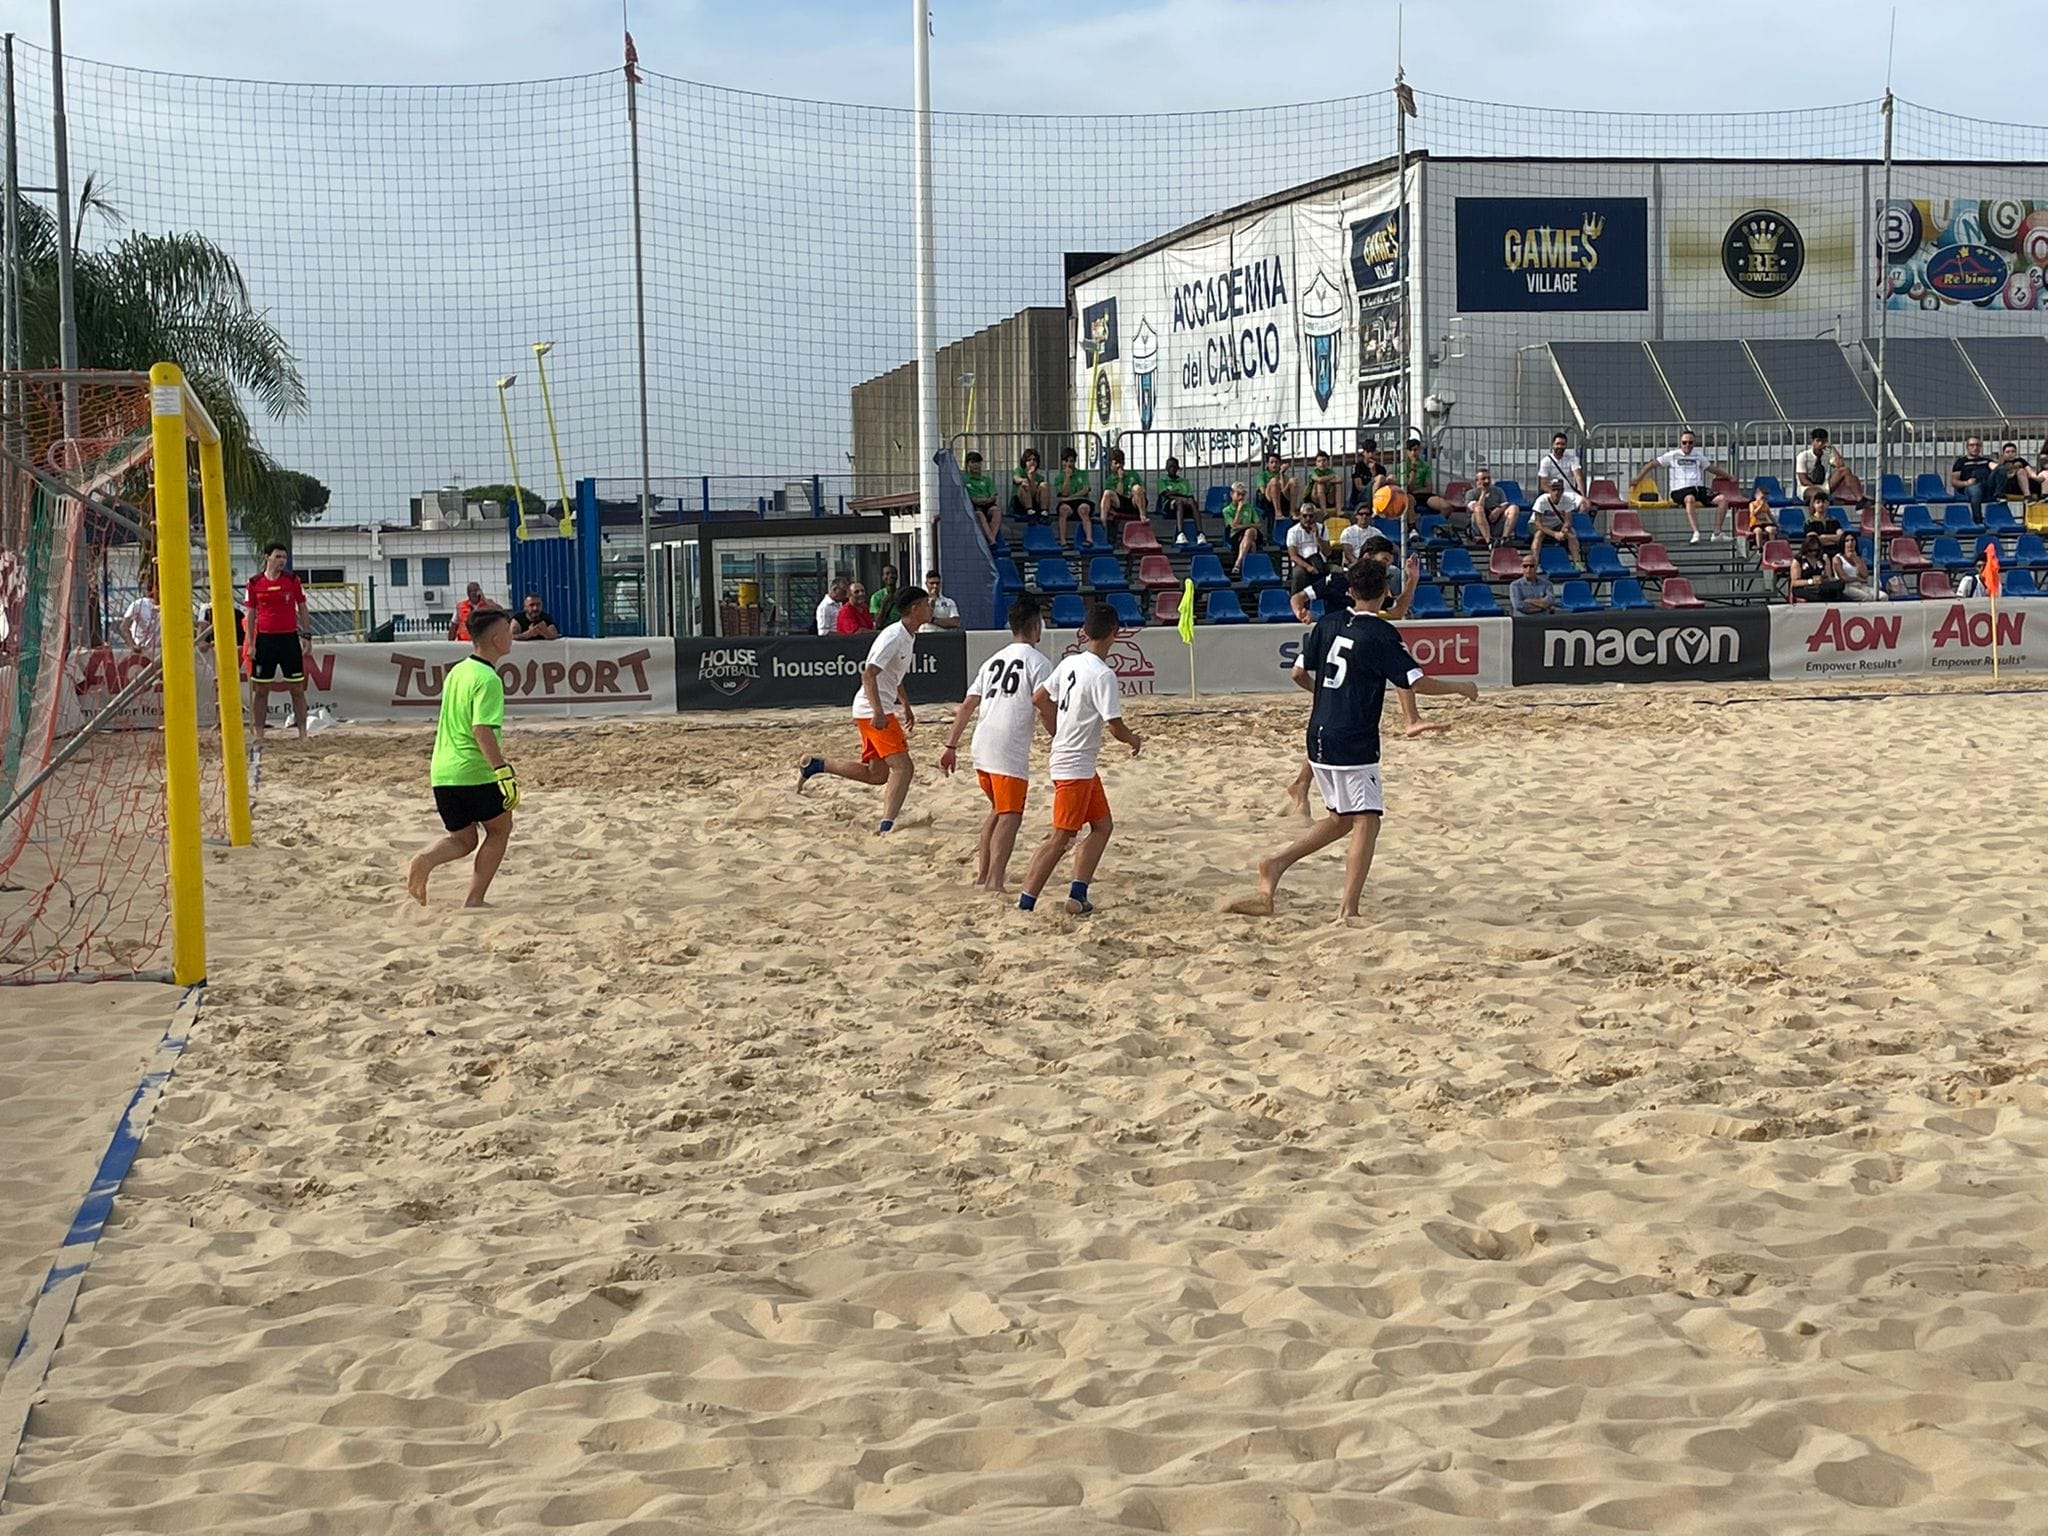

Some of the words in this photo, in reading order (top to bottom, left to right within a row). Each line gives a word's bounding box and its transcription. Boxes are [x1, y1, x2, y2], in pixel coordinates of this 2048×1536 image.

[1887, 215, 1904, 243] B
[1997, 201, 2019, 230] G
[1504, 227, 1599, 270] GAMES
[1747, 254, 1779, 272] RE
[1173, 255, 1288, 333] ACCADEMIA
[1526, 273, 1578, 293] VILLAGE
[1183, 351, 1202, 390] del
[1207, 322, 1280, 386] CALCIO
[1543, 625, 1741, 668] macron
[1805, 608, 1902, 652] AON
[1931, 604, 2027, 648] AON
[391, 648, 652, 698] TUOSPORT
[698, 664, 761, 680] FOOTBALL
[700, 649, 759, 669] HOUSE
[985, 658, 1024, 699] 26
[1322, 635, 1355, 690] 5
[1806, 660, 1857, 674] Empower
[1931, 657, 1982, 669] Empower
